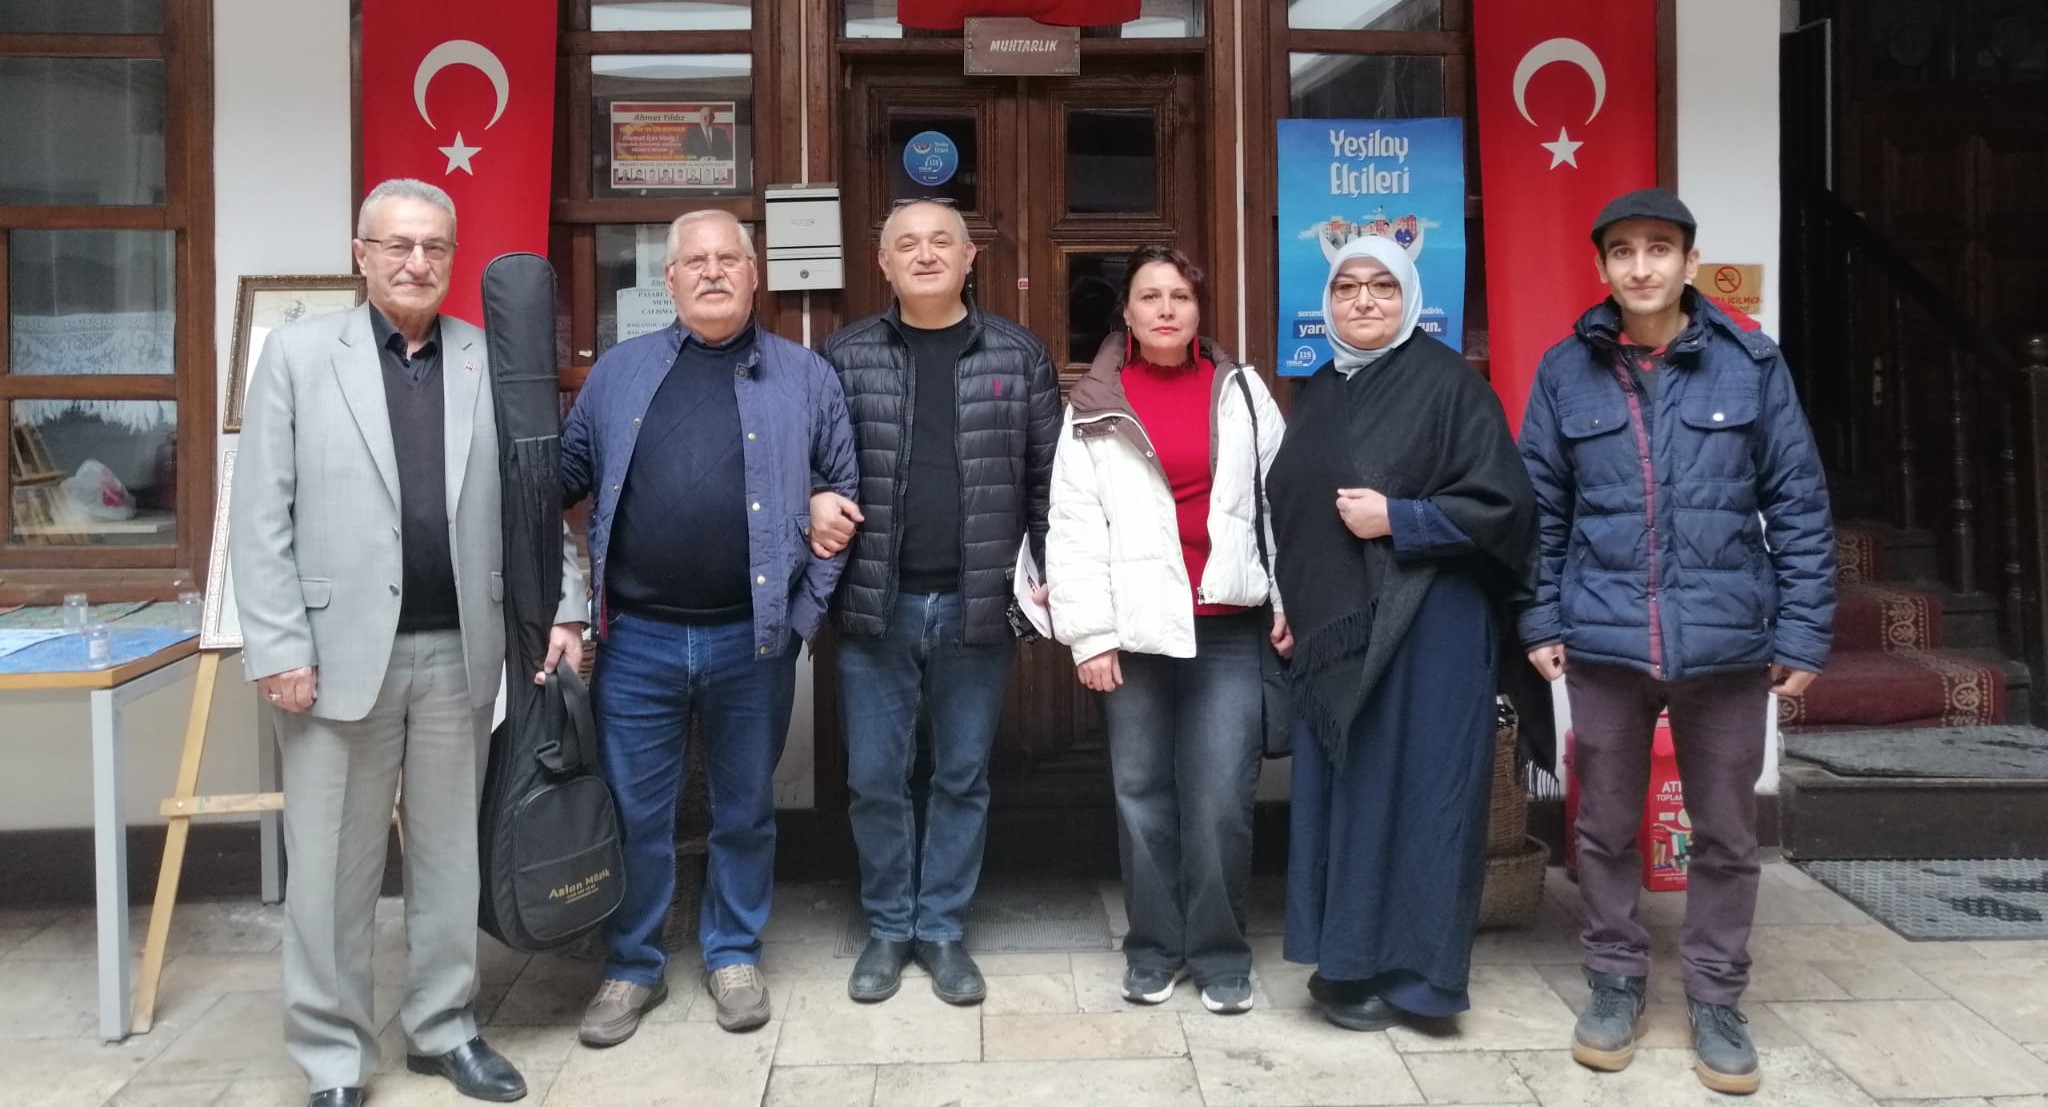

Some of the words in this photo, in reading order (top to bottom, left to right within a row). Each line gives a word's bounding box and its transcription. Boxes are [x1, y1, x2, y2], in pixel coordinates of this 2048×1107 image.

[990, 39, 1058, 52] MUHTARLIK
[1329, 129, 1409, 164] Yeşilay
[1330, 162, 1410, 198] Elçileri
[1662, 781, 1682, 793] ATI
[549, 882, 583, 900] Aslan
